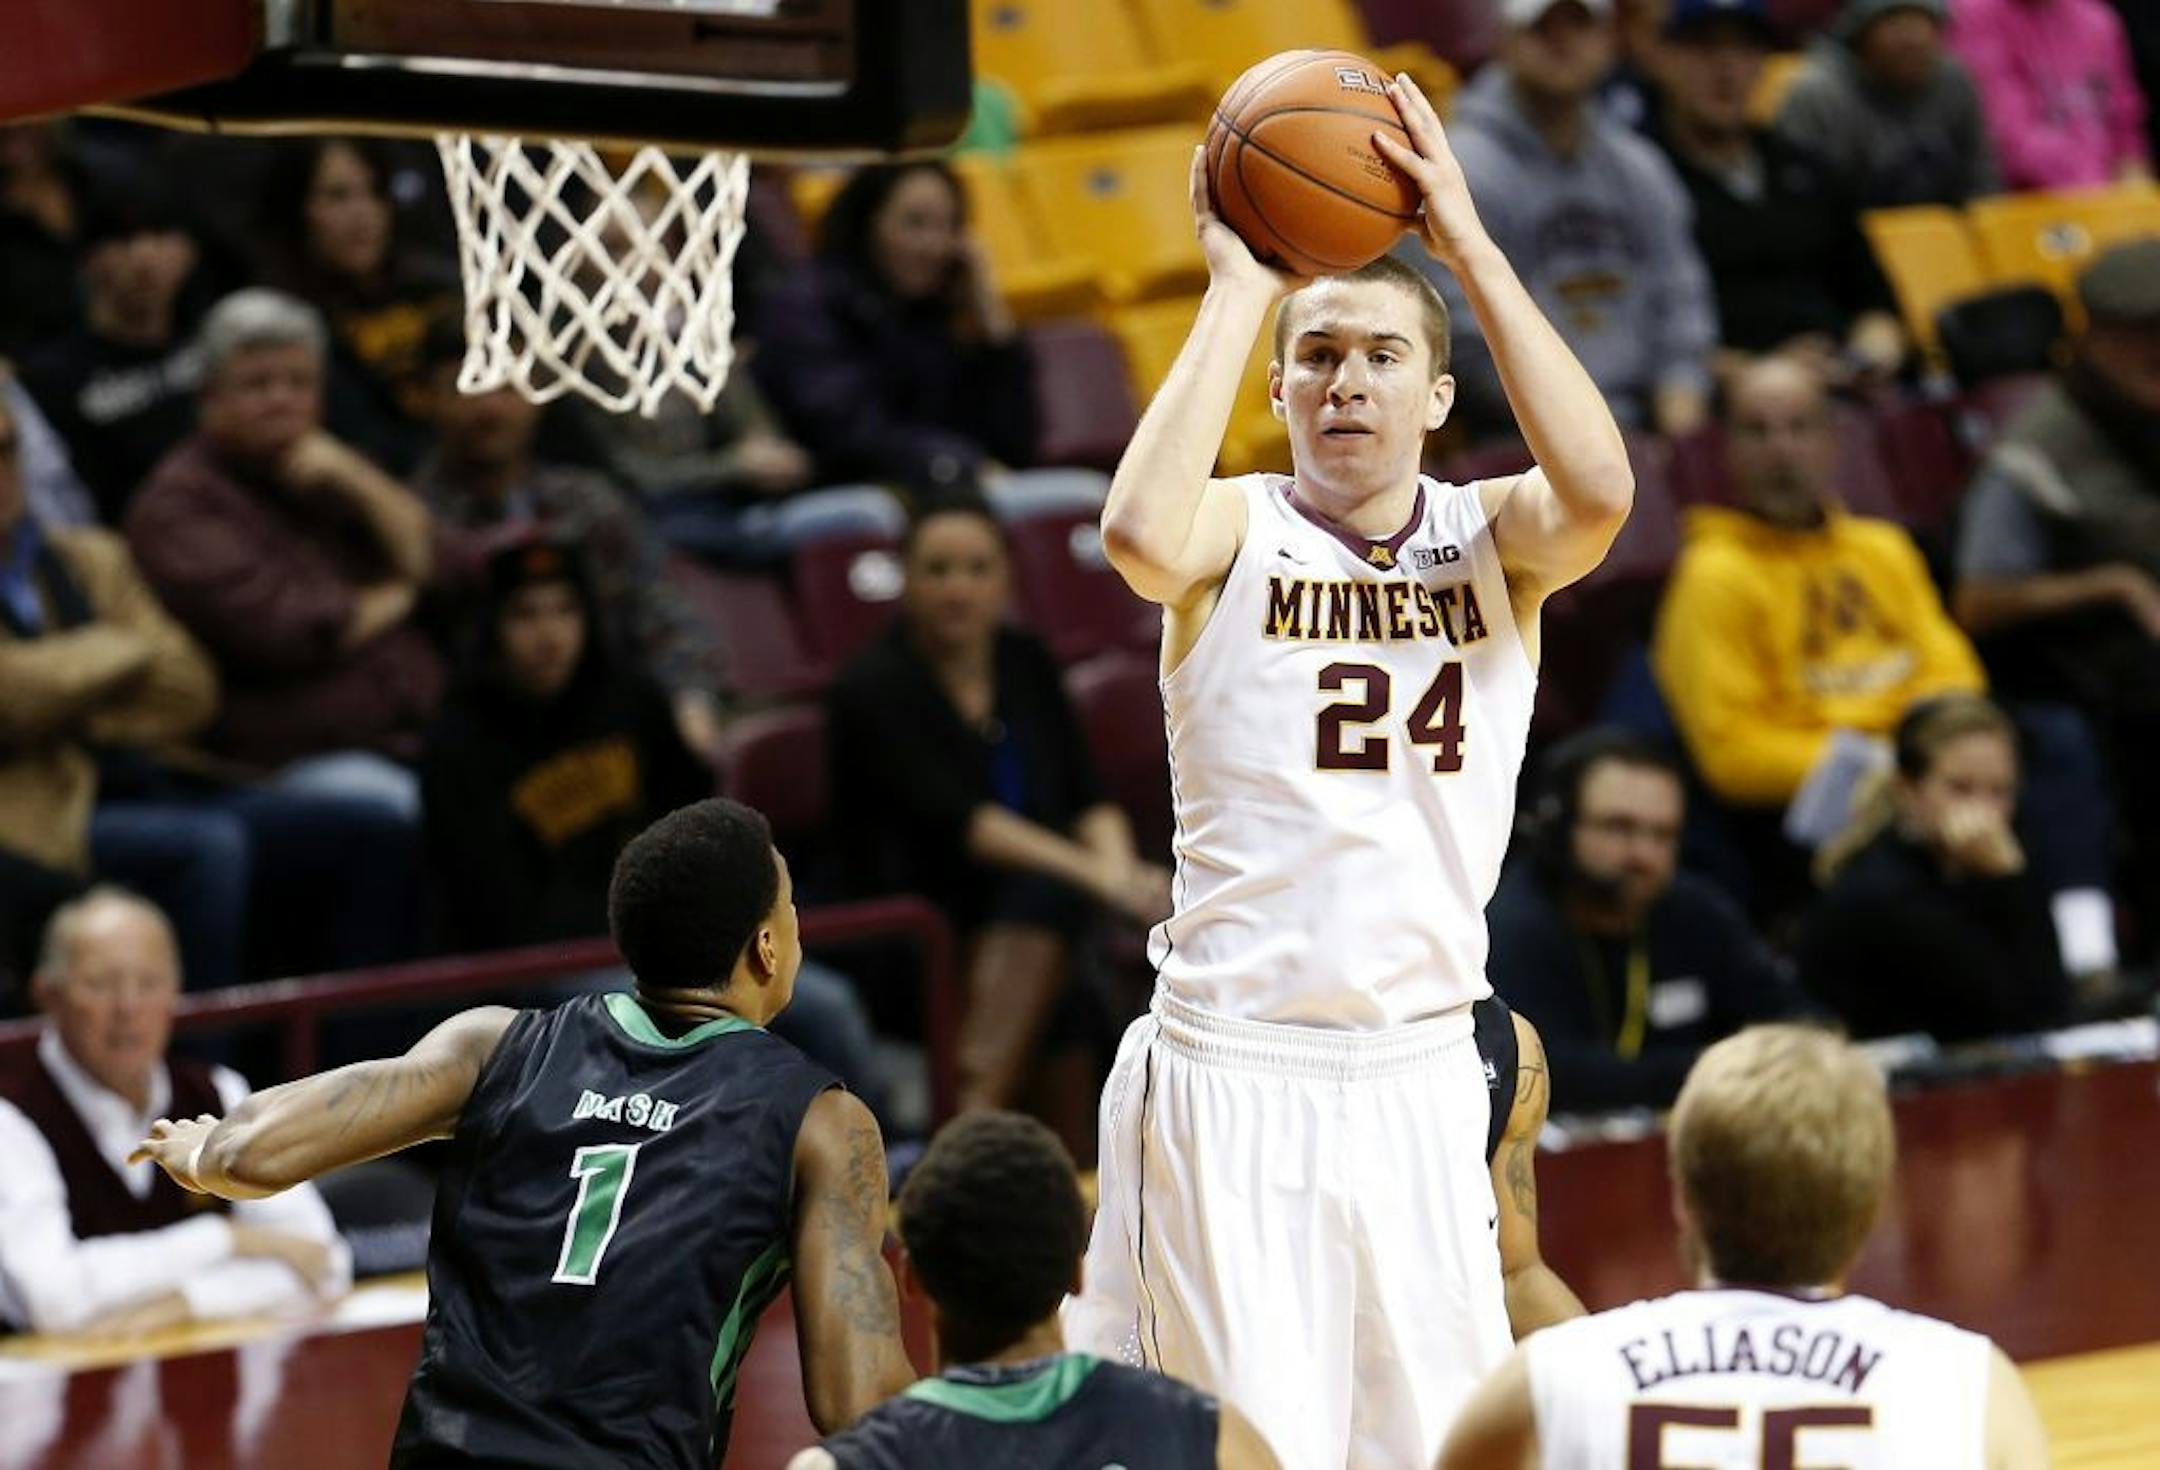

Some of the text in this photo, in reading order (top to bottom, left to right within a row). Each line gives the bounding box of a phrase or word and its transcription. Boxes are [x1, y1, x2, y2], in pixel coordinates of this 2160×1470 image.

[1262, 575, 1489, 648] MINNESTA
[1314, 661, 1467, 774] 24
[551, 1142, 642, 1286] 1
[1620, 1325, 1881, 1394] ELIASON
